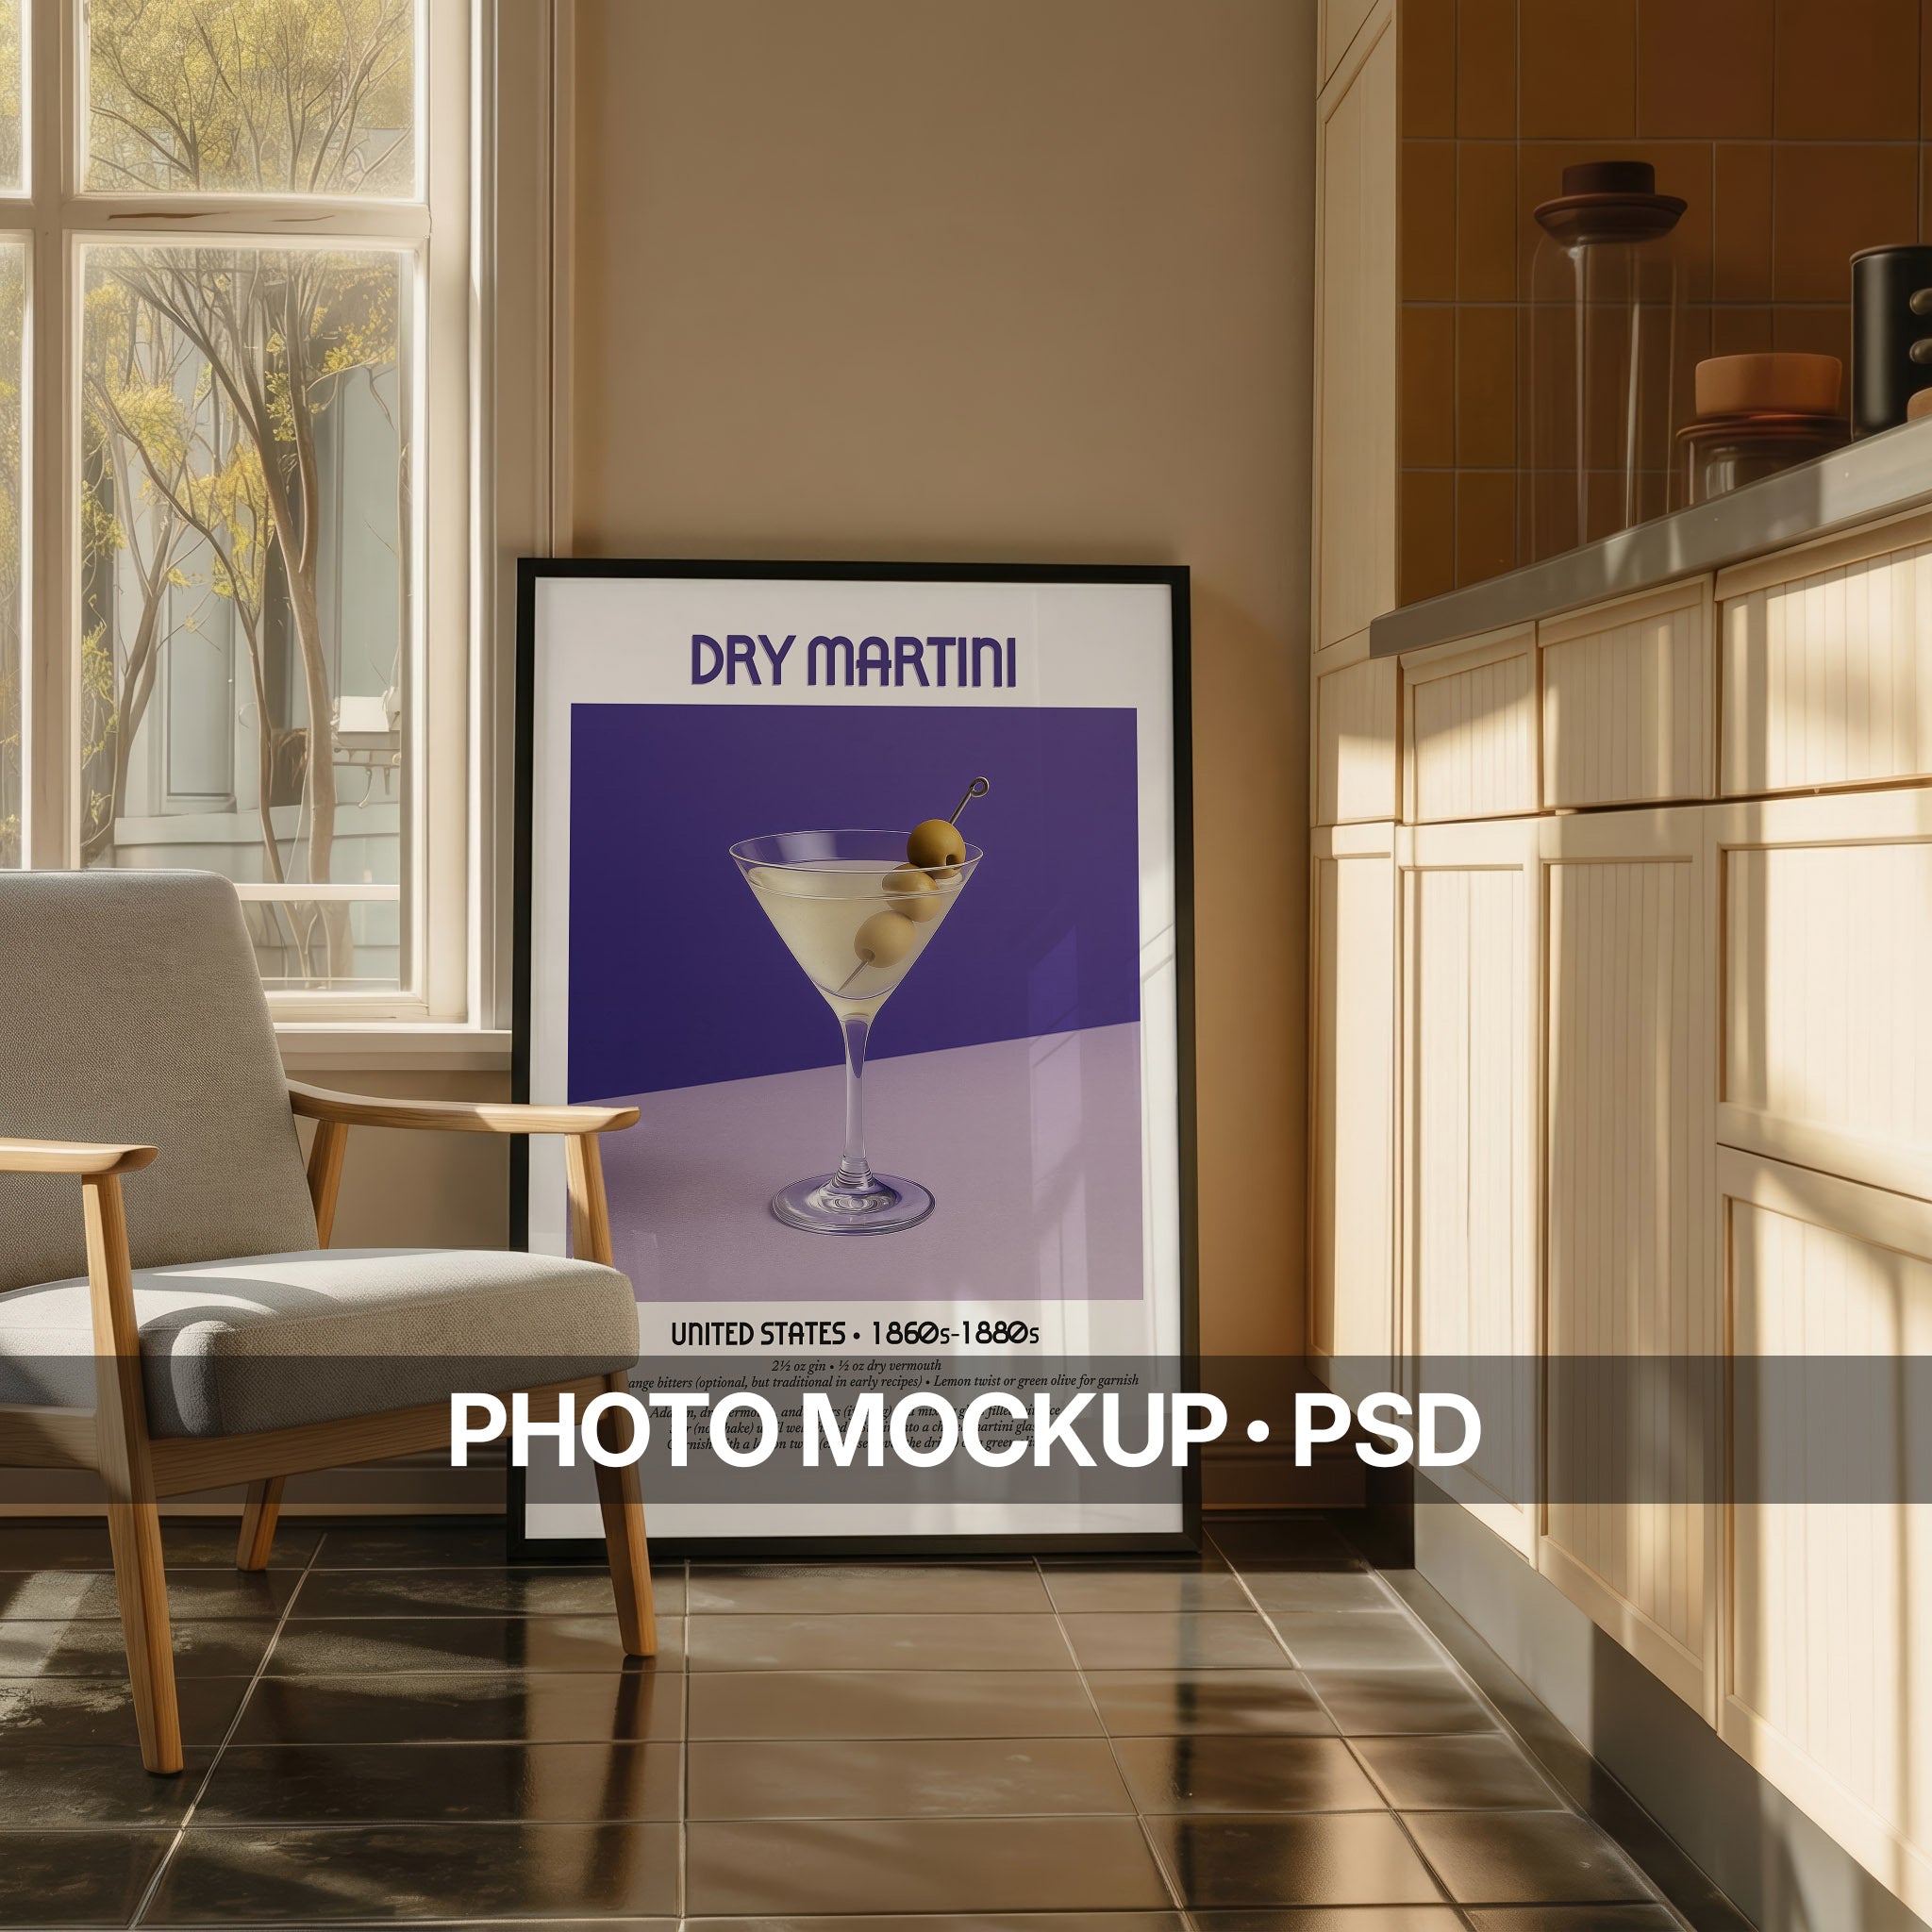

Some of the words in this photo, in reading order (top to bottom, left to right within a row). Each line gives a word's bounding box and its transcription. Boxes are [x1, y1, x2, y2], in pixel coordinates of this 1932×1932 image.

[691, 634, 797, 687] DRY
[808, 635, 1018, 688] MARTINI
[672, 1321, 754, 1346] UNITED
[760, 1321, 846, 1345] STATES
[793, 1363, 807, 1372] oz
[808, 1359, 826, 1374] gin
[852, 1363, 865, 1372] oz
[867, 1358, 886, 1374] dry
[889, 1358, 941, 1371] vermouth
[627, 1379, 655, 1391] ange
[657, 1375, 693, 1389] bitters
[695, 1375, 748, 1391] (optional,
[752, 1375, 771, 1389] but
[773, 1374, 834, 1388] traditional
[836, 1374, 847, 1388] in
[850, 1374, 878, 1391] early
[880, 1374, 923, 1391] recipes)
[933, 1374, 972, 1388] Lemon
[974, 1374, 1001, 1388] twist
[1003, 1378, 1017, 1387] or
[1017, 1377, 1048, 1390] green
[1050, 1374, 1076, 1387] olive
[1075, 1374, 1096, 1390] for
[1096, 1374, 1140, 1390] garnish
[781, 1405, 803, 1417] and
[725, 1421, 755, 1435] hake)
[907, 1436, 922, 1449] he
